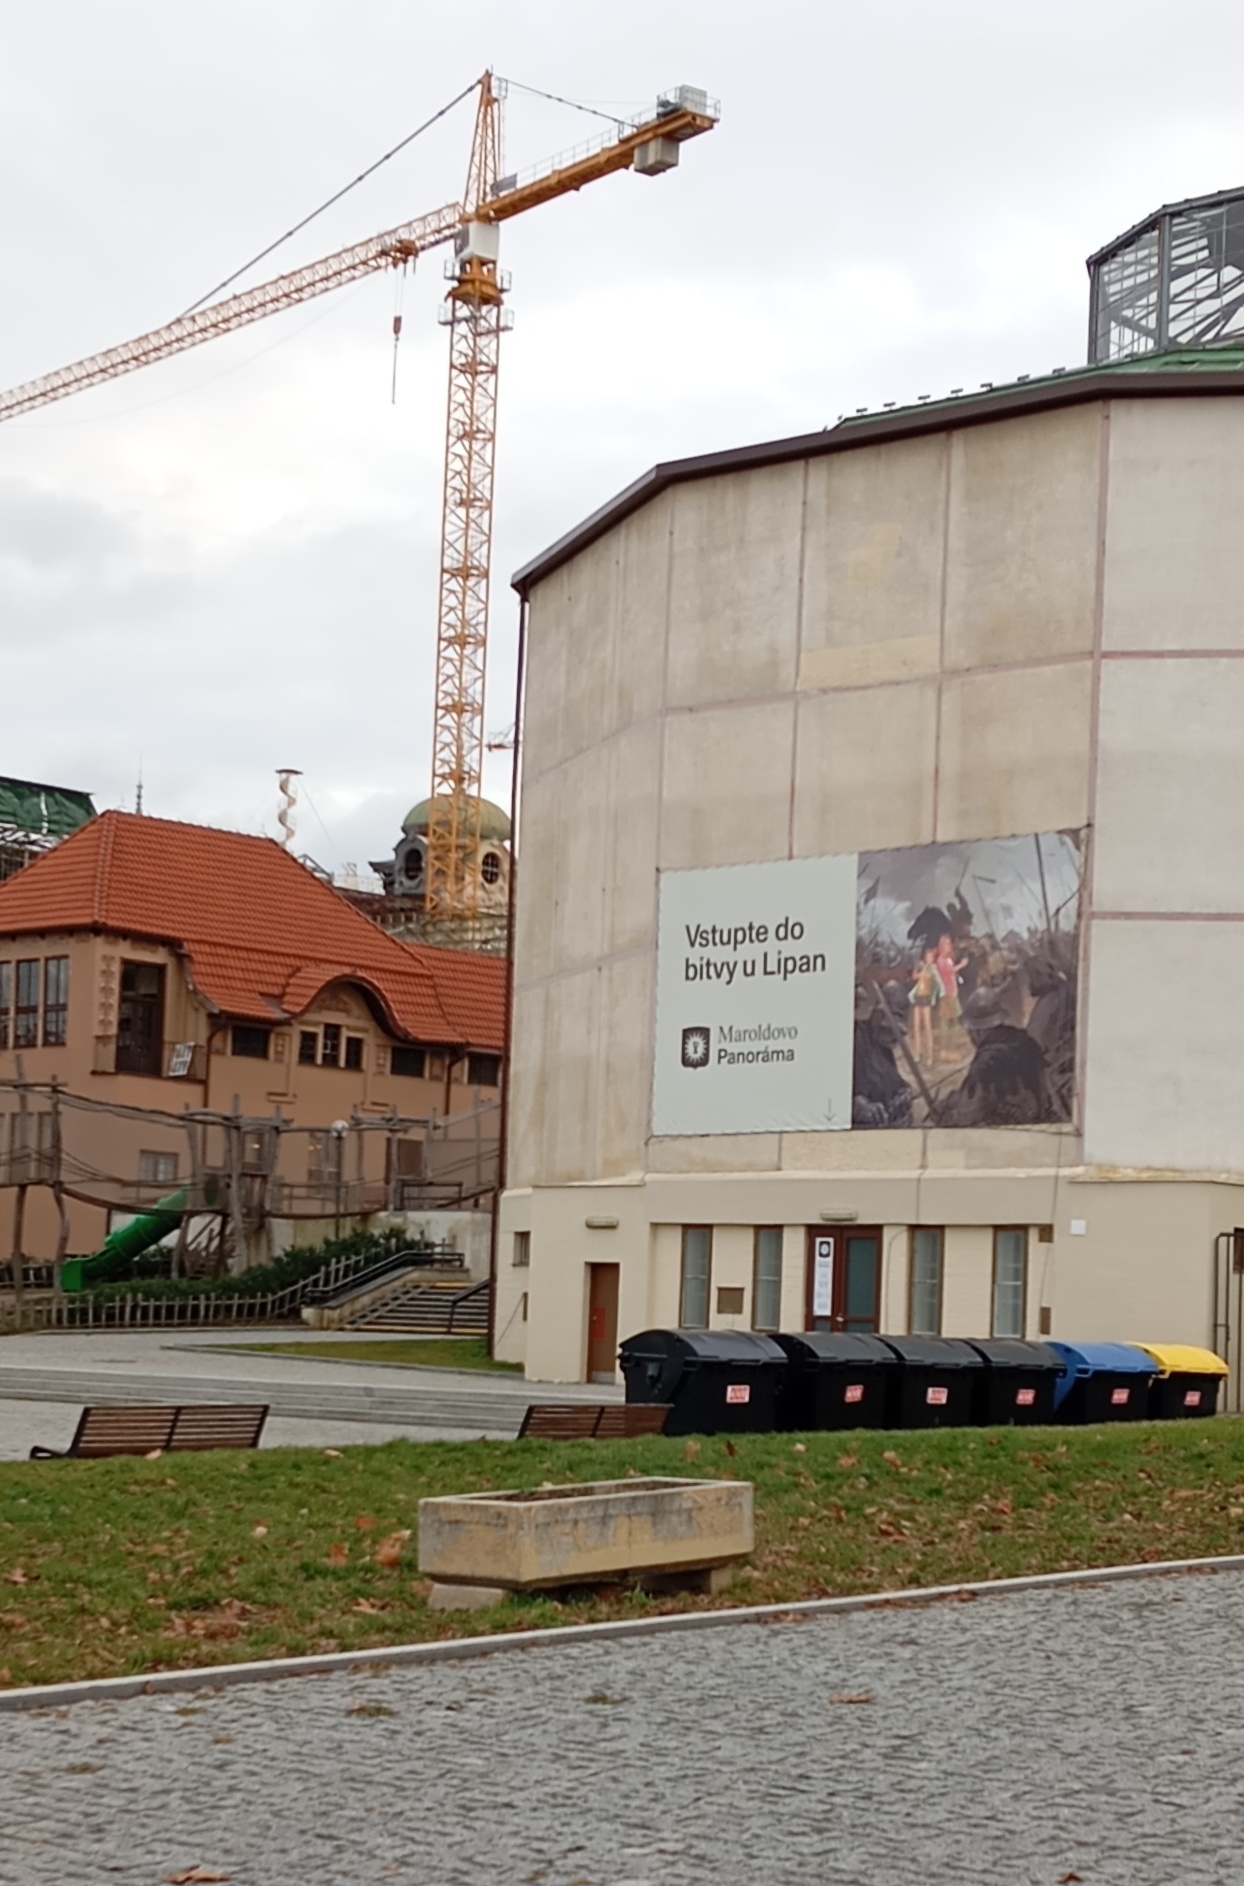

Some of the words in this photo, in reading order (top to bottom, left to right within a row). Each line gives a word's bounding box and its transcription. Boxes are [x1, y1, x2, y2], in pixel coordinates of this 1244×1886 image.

[685, 921, 769, 952] Vstupte
[775, 916, 804, 941] do
[685, 956, 738, 985] bitvy
[743, 959, 756, 977] u
[763, 950, 826, 981] Lipan
[718, 1023, 798, 1044] Maroldovo
[717, 1045, 795, 1065] Panoráma
